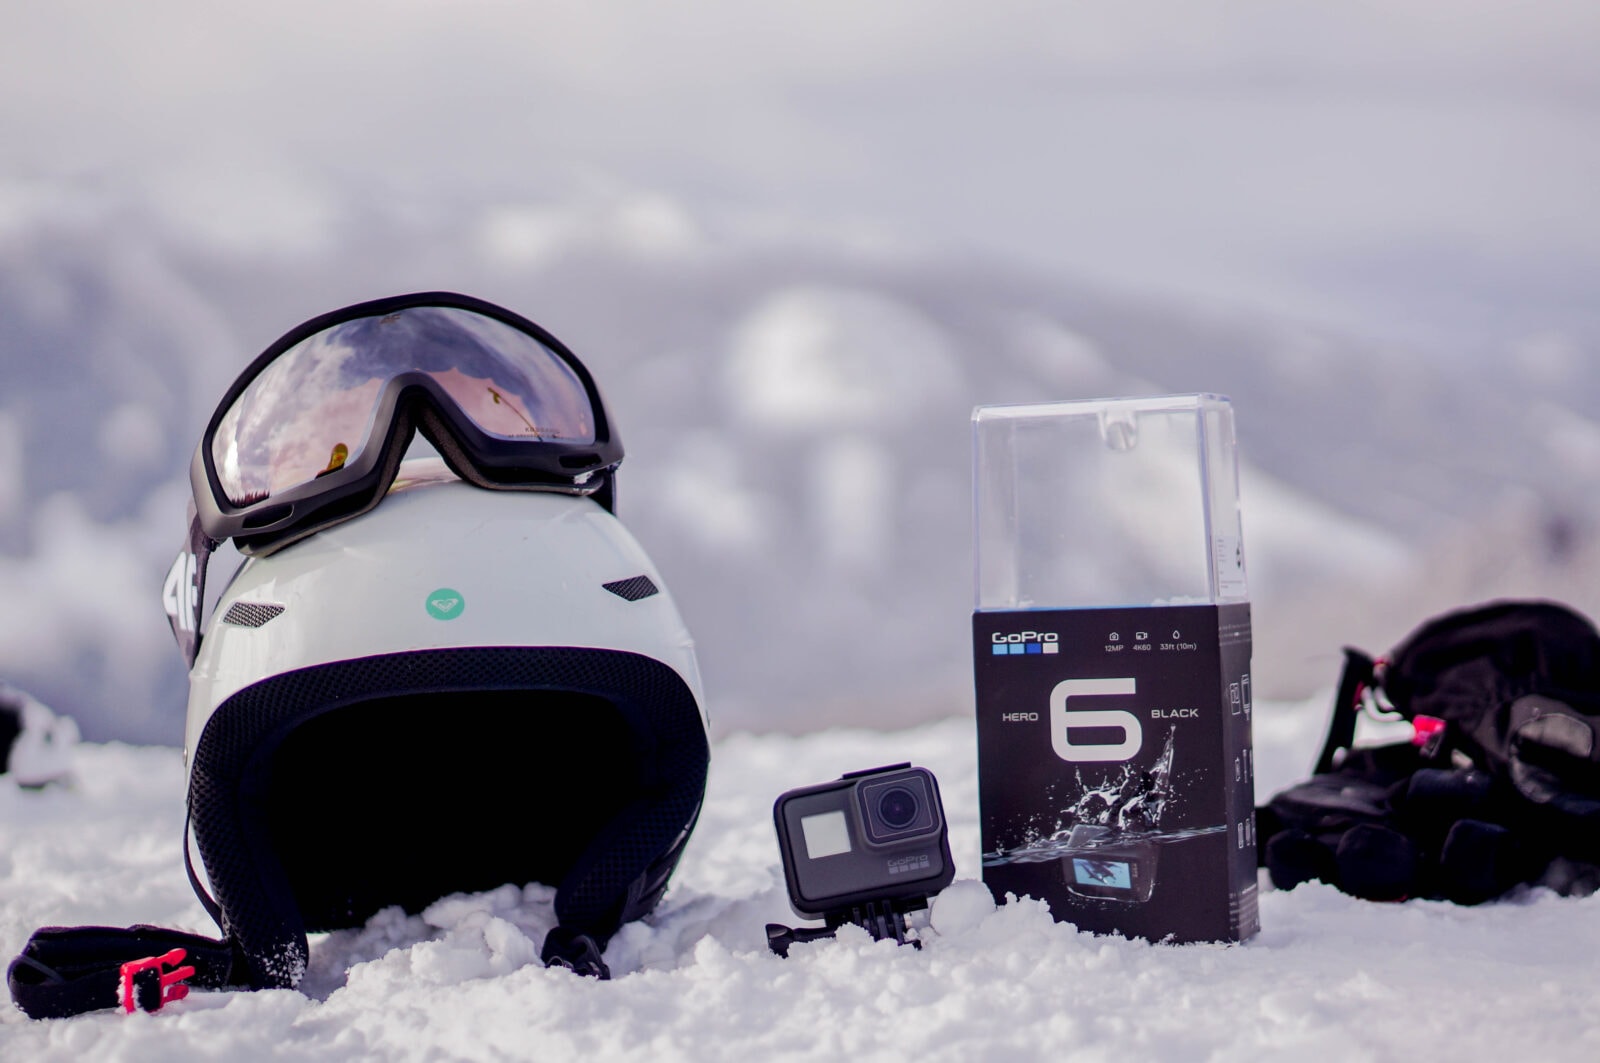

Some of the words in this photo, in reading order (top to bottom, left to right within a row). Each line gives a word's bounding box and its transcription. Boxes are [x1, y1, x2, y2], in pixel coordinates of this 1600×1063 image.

[992, 631, 1058, 643] GoPro
[1105, 644, 1124, 652] 12MP
[1133, 643, 1152, 651] 4K60
[1159, 643, 1175, 651] 33ft
[1176, 642, 1197, 652] (10m)
[1002, 712, 1039, 722] HERO
[1049, 677, 1143, 762] 6
[1151, 708, 1199, 719] BLACK
[887, 854, 928, 867] GoPro
